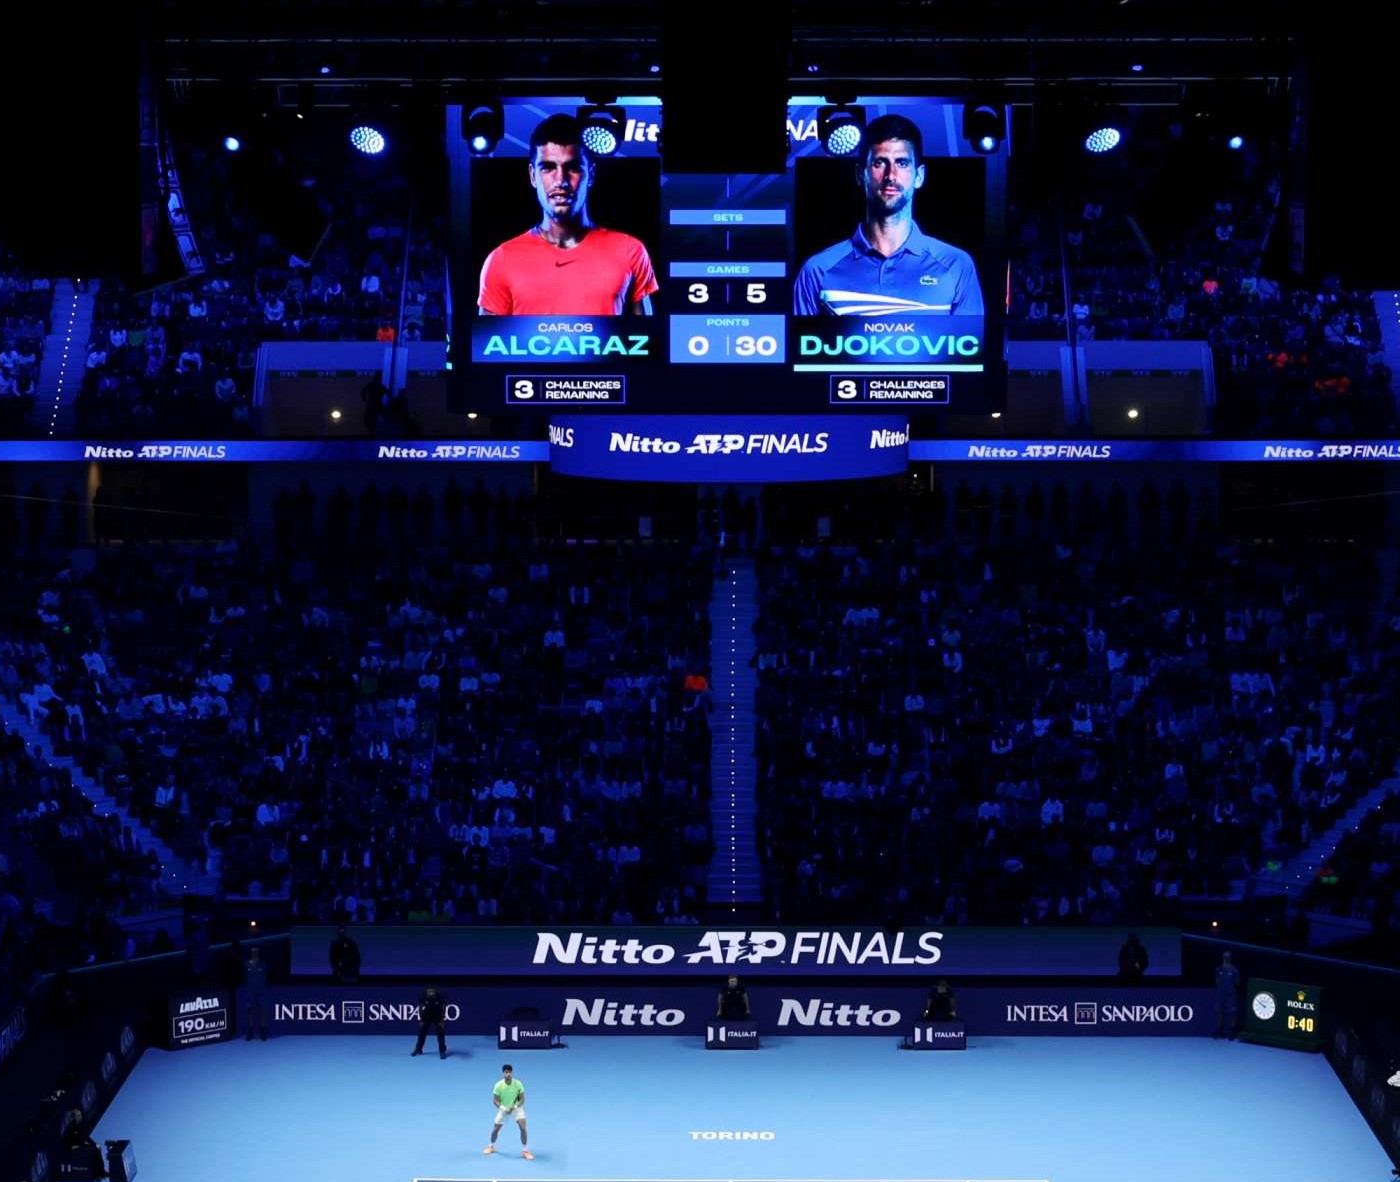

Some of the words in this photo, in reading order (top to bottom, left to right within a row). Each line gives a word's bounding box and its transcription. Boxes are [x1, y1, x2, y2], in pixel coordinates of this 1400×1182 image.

[688, 284, 709, 303] 3
[747, 284, 766, 303] 5
[538, 323, 593, 332] CARLOS
[865, 323, 914, 333] NOVAK
[483, 335, 648, 355] ALCARAZ
[688, 336, 709, 355] 0
[736, 336, 777, 356] 30
[801, 335, 978, 355] DJOKOVIC
[515, 380, 534, 398] 3
[546, 381, 620, 389] CHALLENGES
[546, 391, 609, 399] REMAINING
[838, 380, 857, 398] 3
[870, 381, 945, 389] CHALLENGES
[610, 433, 680, 453] Nitto
[747, 433, 828, 453] FINALS
[870, 429, 905, 449] Nitto
[85, 446, 133, 457] Nitto
[173, 446, 225, 458] FINALS
[378, 446, 427, 458] Nitto
[467, 446, 520, 458] FINALS
[968, 446, 1017, 457] Nitto
[1057, 446, 1110, 458] FINALS
[1264, 446, 1313, 458] Nitto
[533, 933, 675, 964] Nitto
[683, 932, 787, 964] ATP
[791, 932, 943, 964] FINALS
[180, 997, 219, 1013] LAVAZZA
[275, 1004, 335, 1020] INTESA
[369, 1004, 460, 1020] SANPAO
[562, 999, 685, 1025] Nitto
[778, 999, 900, 1026] Nitto
[1008, 1005, 1068, 1021] INTESA
[1102, 1005, 1193, 1021] SANPAOLO
[1288, 1000, 1314, 1010] ROLEX
[178, 1018, 204, 1034] 190
[205, 1020, 224, 1029] KM/H
[1288, 1016, 1313, 1032] 0:40
[690, 1132, 775, 1140] TORINO
